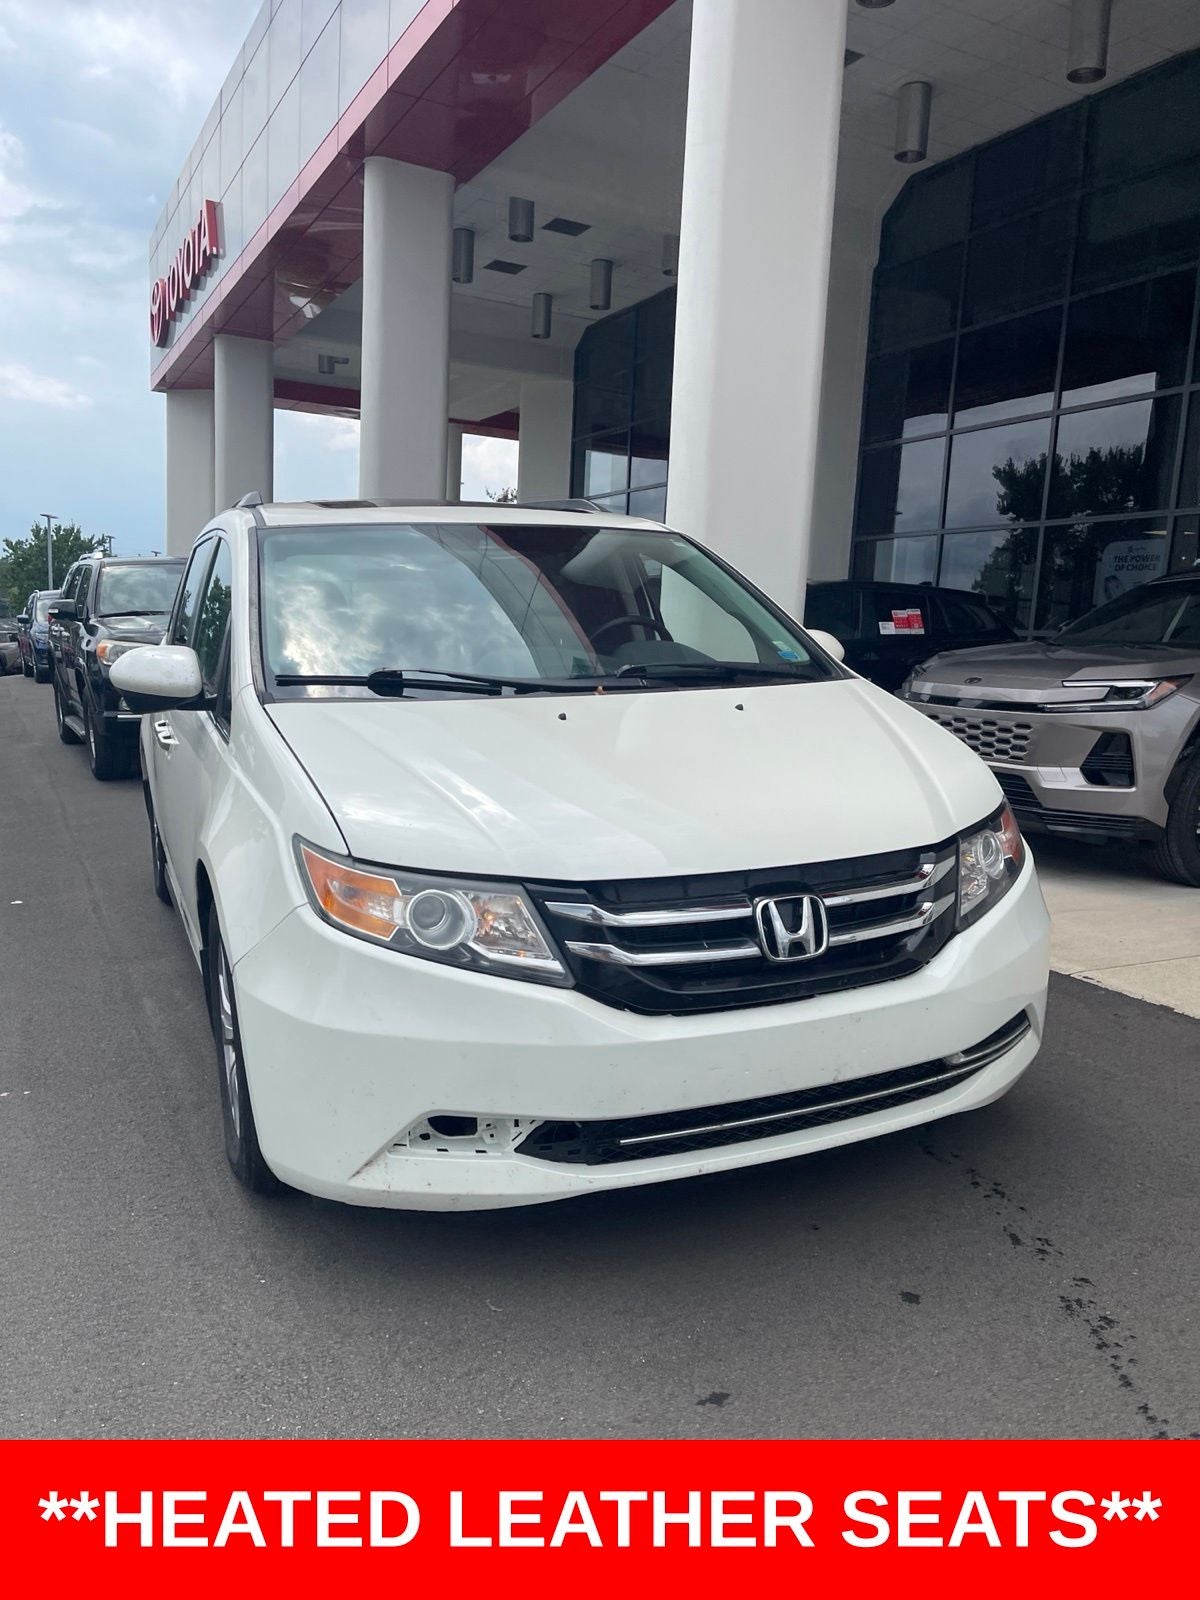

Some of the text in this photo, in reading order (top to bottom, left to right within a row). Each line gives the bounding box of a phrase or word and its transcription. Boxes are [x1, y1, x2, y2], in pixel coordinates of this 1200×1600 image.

[164, 199, 218, 322] TOYOTA
[1113, 553, 1161, 563] THE POWER
[1114, 563, 1157, 571] OF CHOICE
